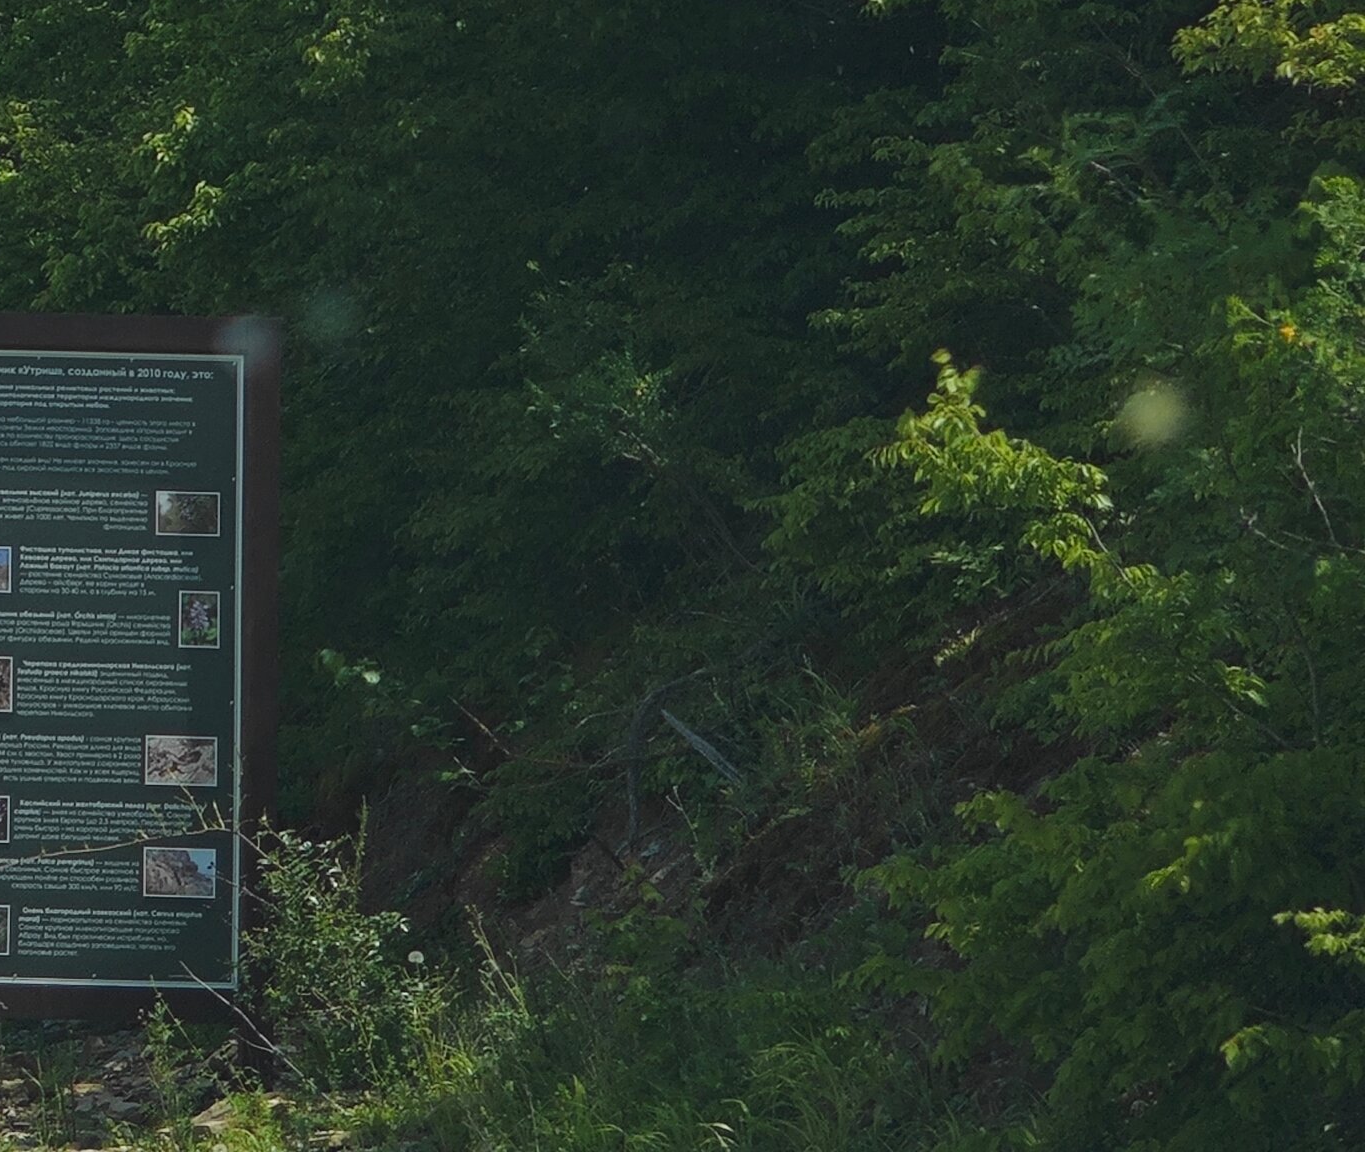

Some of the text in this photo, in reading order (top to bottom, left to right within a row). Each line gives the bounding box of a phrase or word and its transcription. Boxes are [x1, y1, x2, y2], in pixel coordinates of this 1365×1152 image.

[67, 365, 126, 378] созданный
[128, 369, 135, 377] в
[136, 366, 161, 378] 2010
[162, 370, 190, 381] году,
